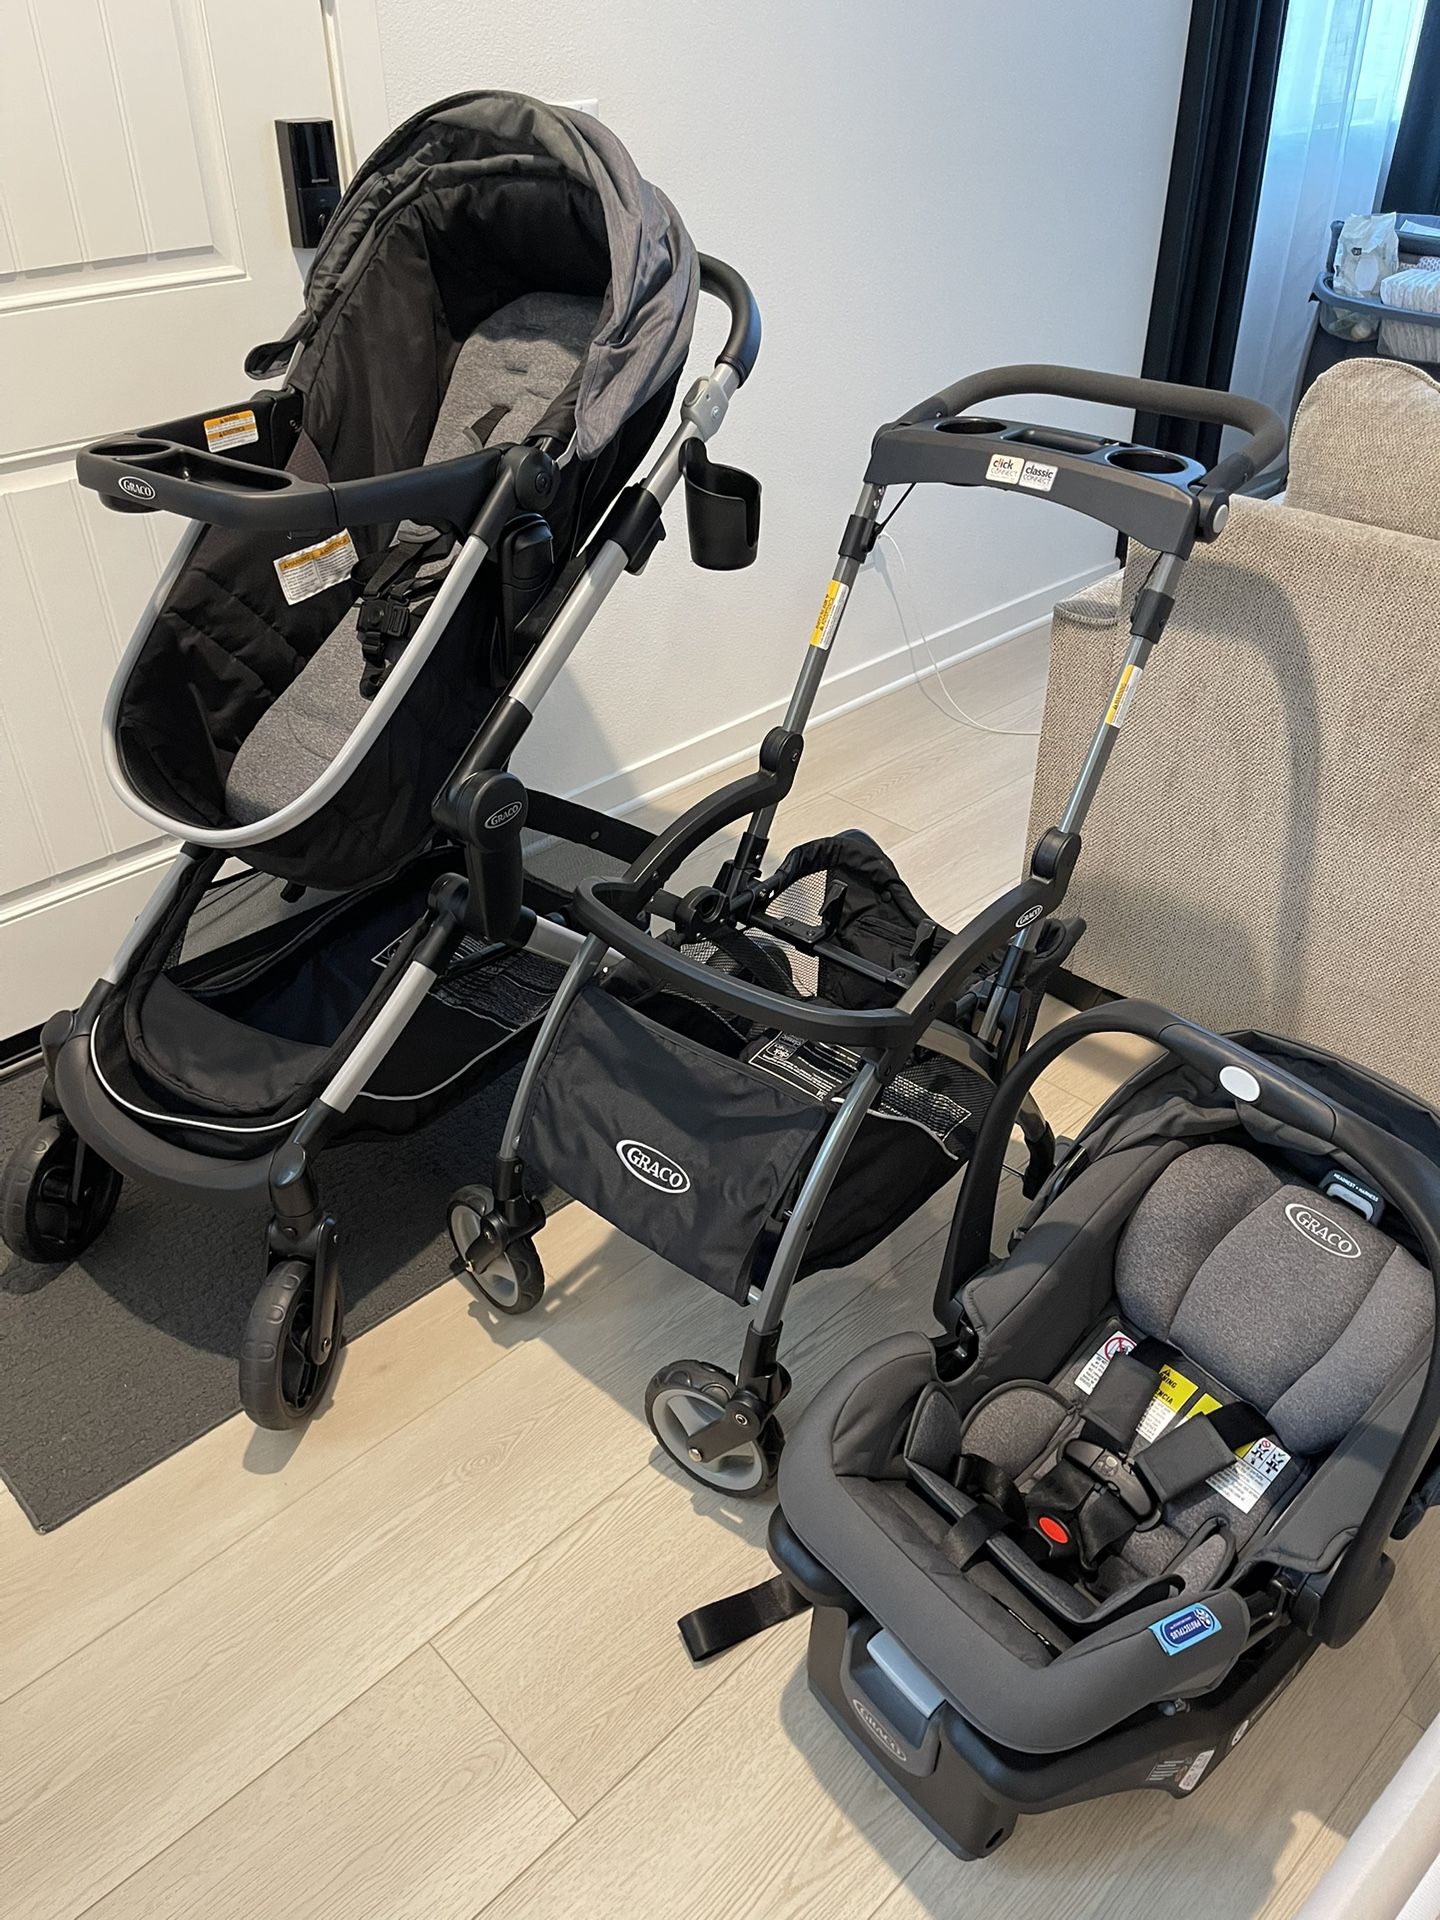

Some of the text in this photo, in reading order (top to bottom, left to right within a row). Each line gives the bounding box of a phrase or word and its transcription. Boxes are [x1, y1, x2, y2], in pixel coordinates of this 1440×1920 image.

[993, 458, 1014, 470] click
[1025, 464, 1054, 479] classic
[123, 479, 152, 497] GRACO
[490, 804, 519, 826] GRACO
[627, 1147, 683, 1188] GRACO
[1296, 1211, 1353, 1253] GRACO
[1161, 1374, 1178, 1390] NING
[1155, 1389, 1174, 1405] ENCIA
